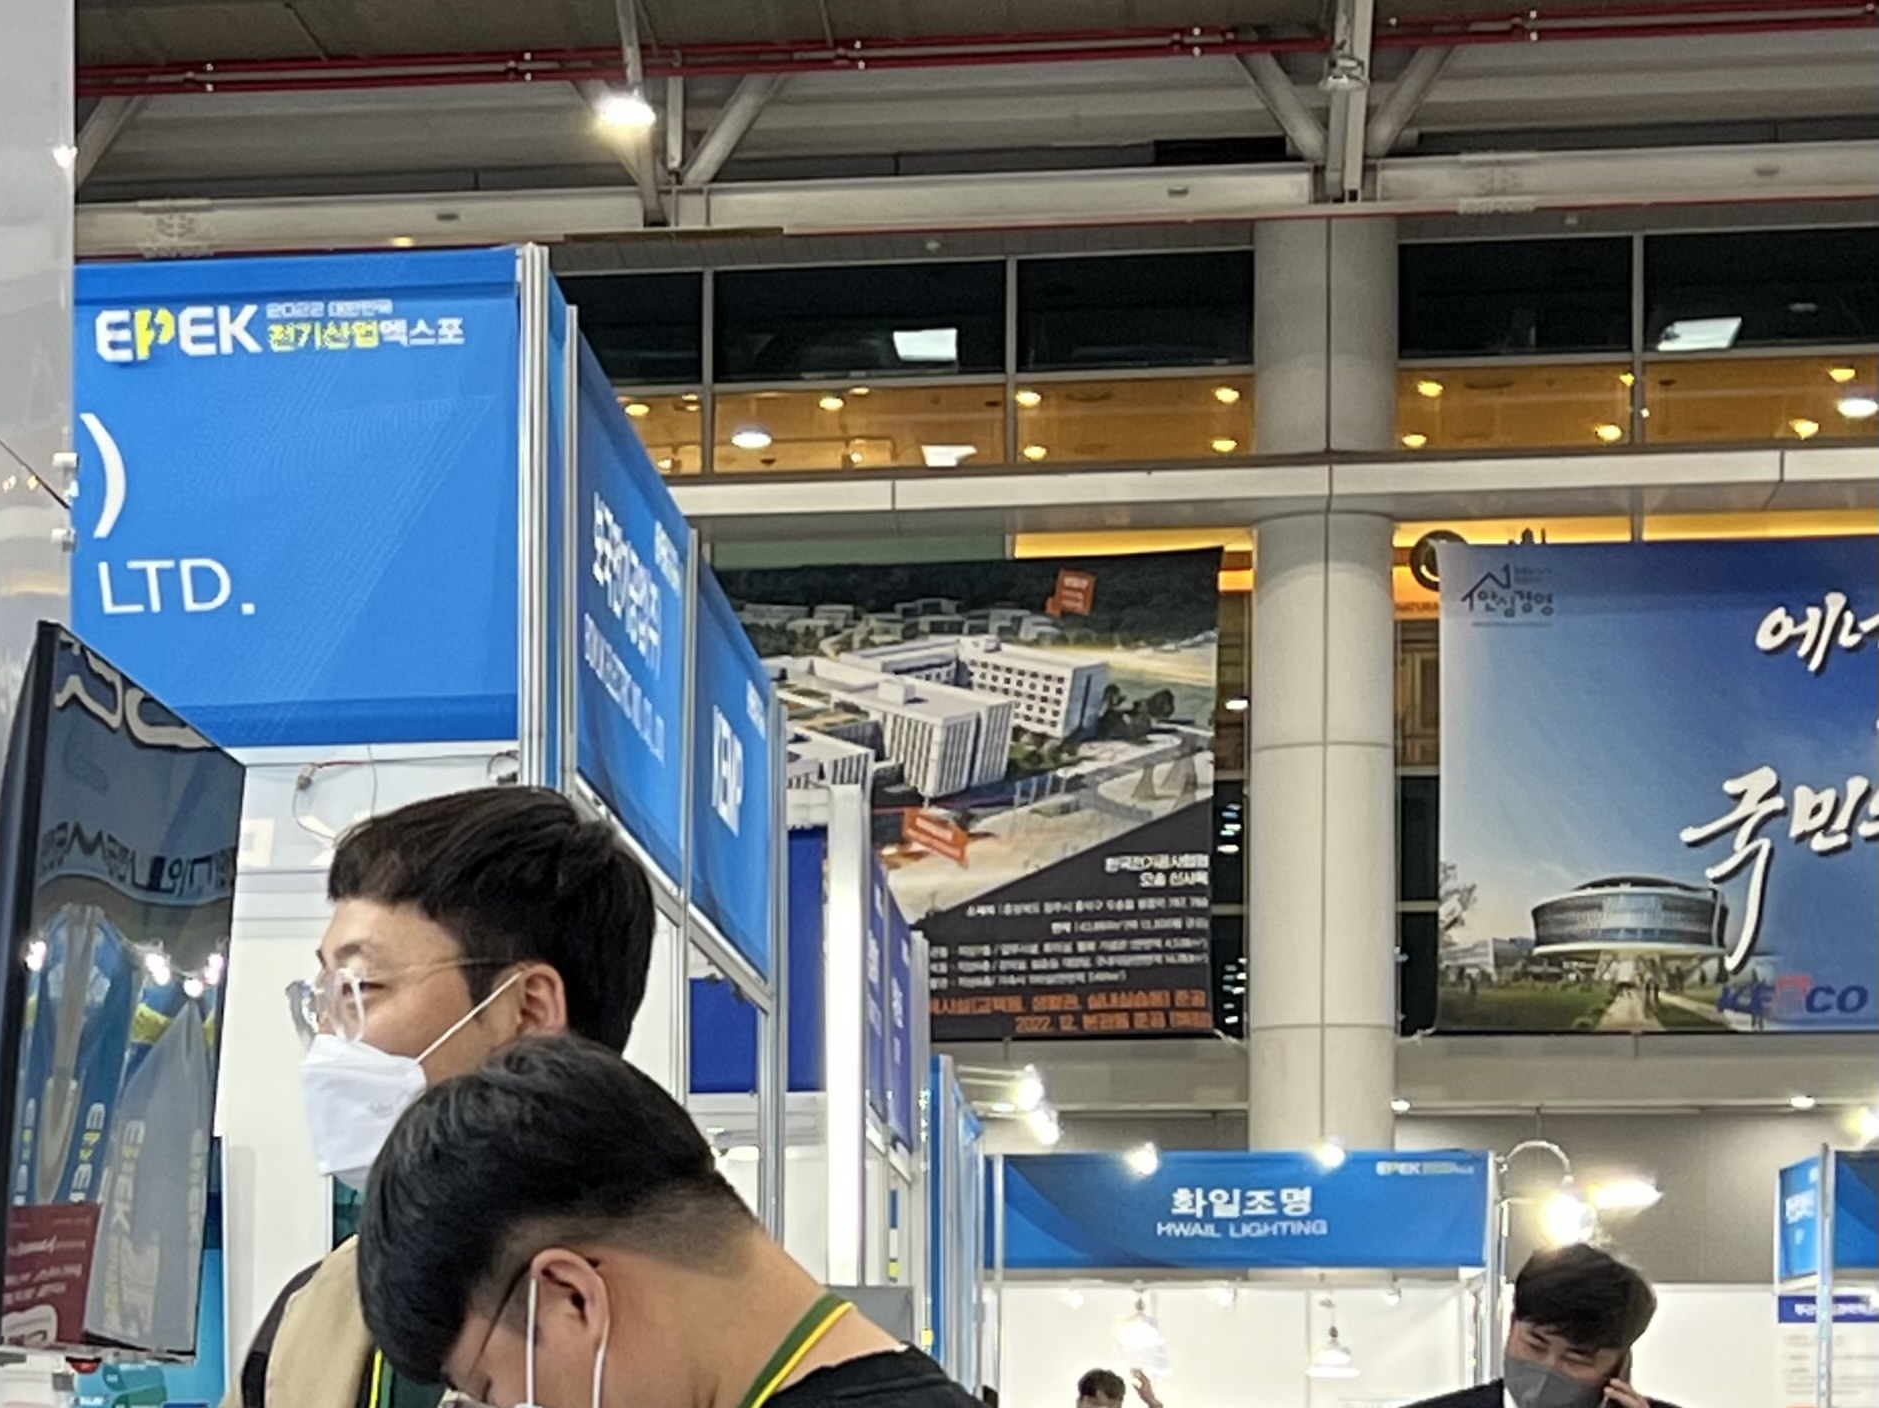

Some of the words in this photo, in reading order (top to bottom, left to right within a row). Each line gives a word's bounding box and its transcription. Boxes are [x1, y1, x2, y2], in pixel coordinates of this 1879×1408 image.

[95, 304, 263, 362] EPEK
[267, 317, 465, 353] 전기산업엑스포
[98, 556, 256, 616] LTD.
[1171, 1186, 1313, 1219] 화일조명
